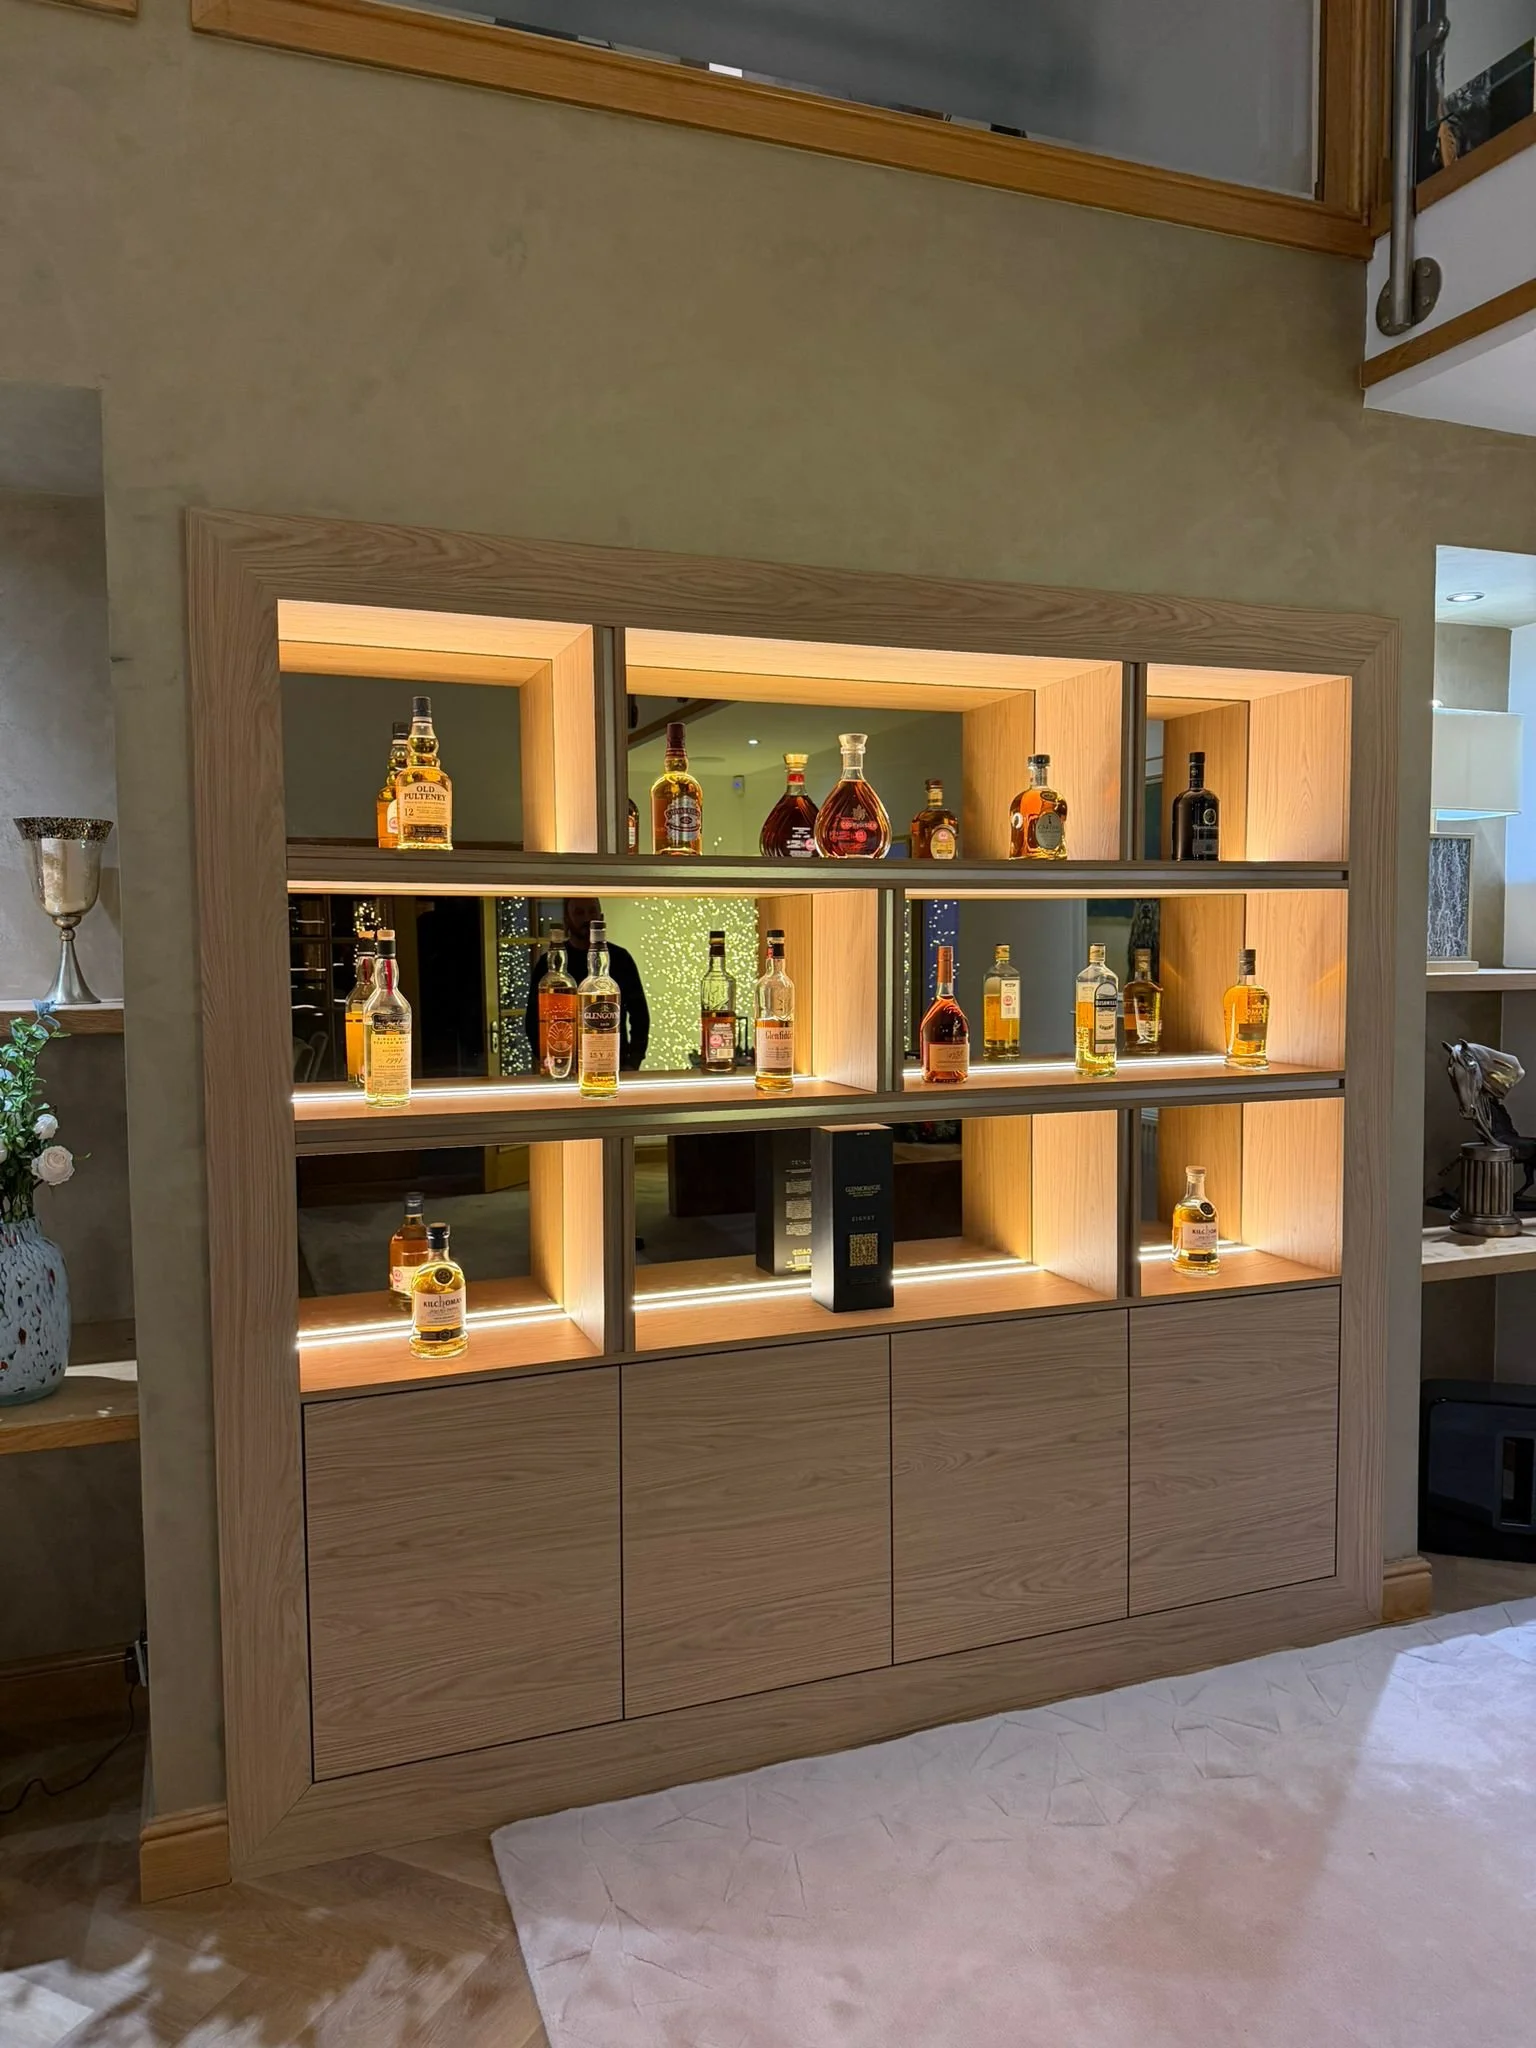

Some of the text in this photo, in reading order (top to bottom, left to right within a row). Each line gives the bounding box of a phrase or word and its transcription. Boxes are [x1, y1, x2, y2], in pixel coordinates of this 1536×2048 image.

[416, 785, 435, 793] OLD
[404, 793, 446, 801] PULTENEY
[404, 807, 414, 816] 12
[583, 1011, 619, 1020] GLENGOYN
